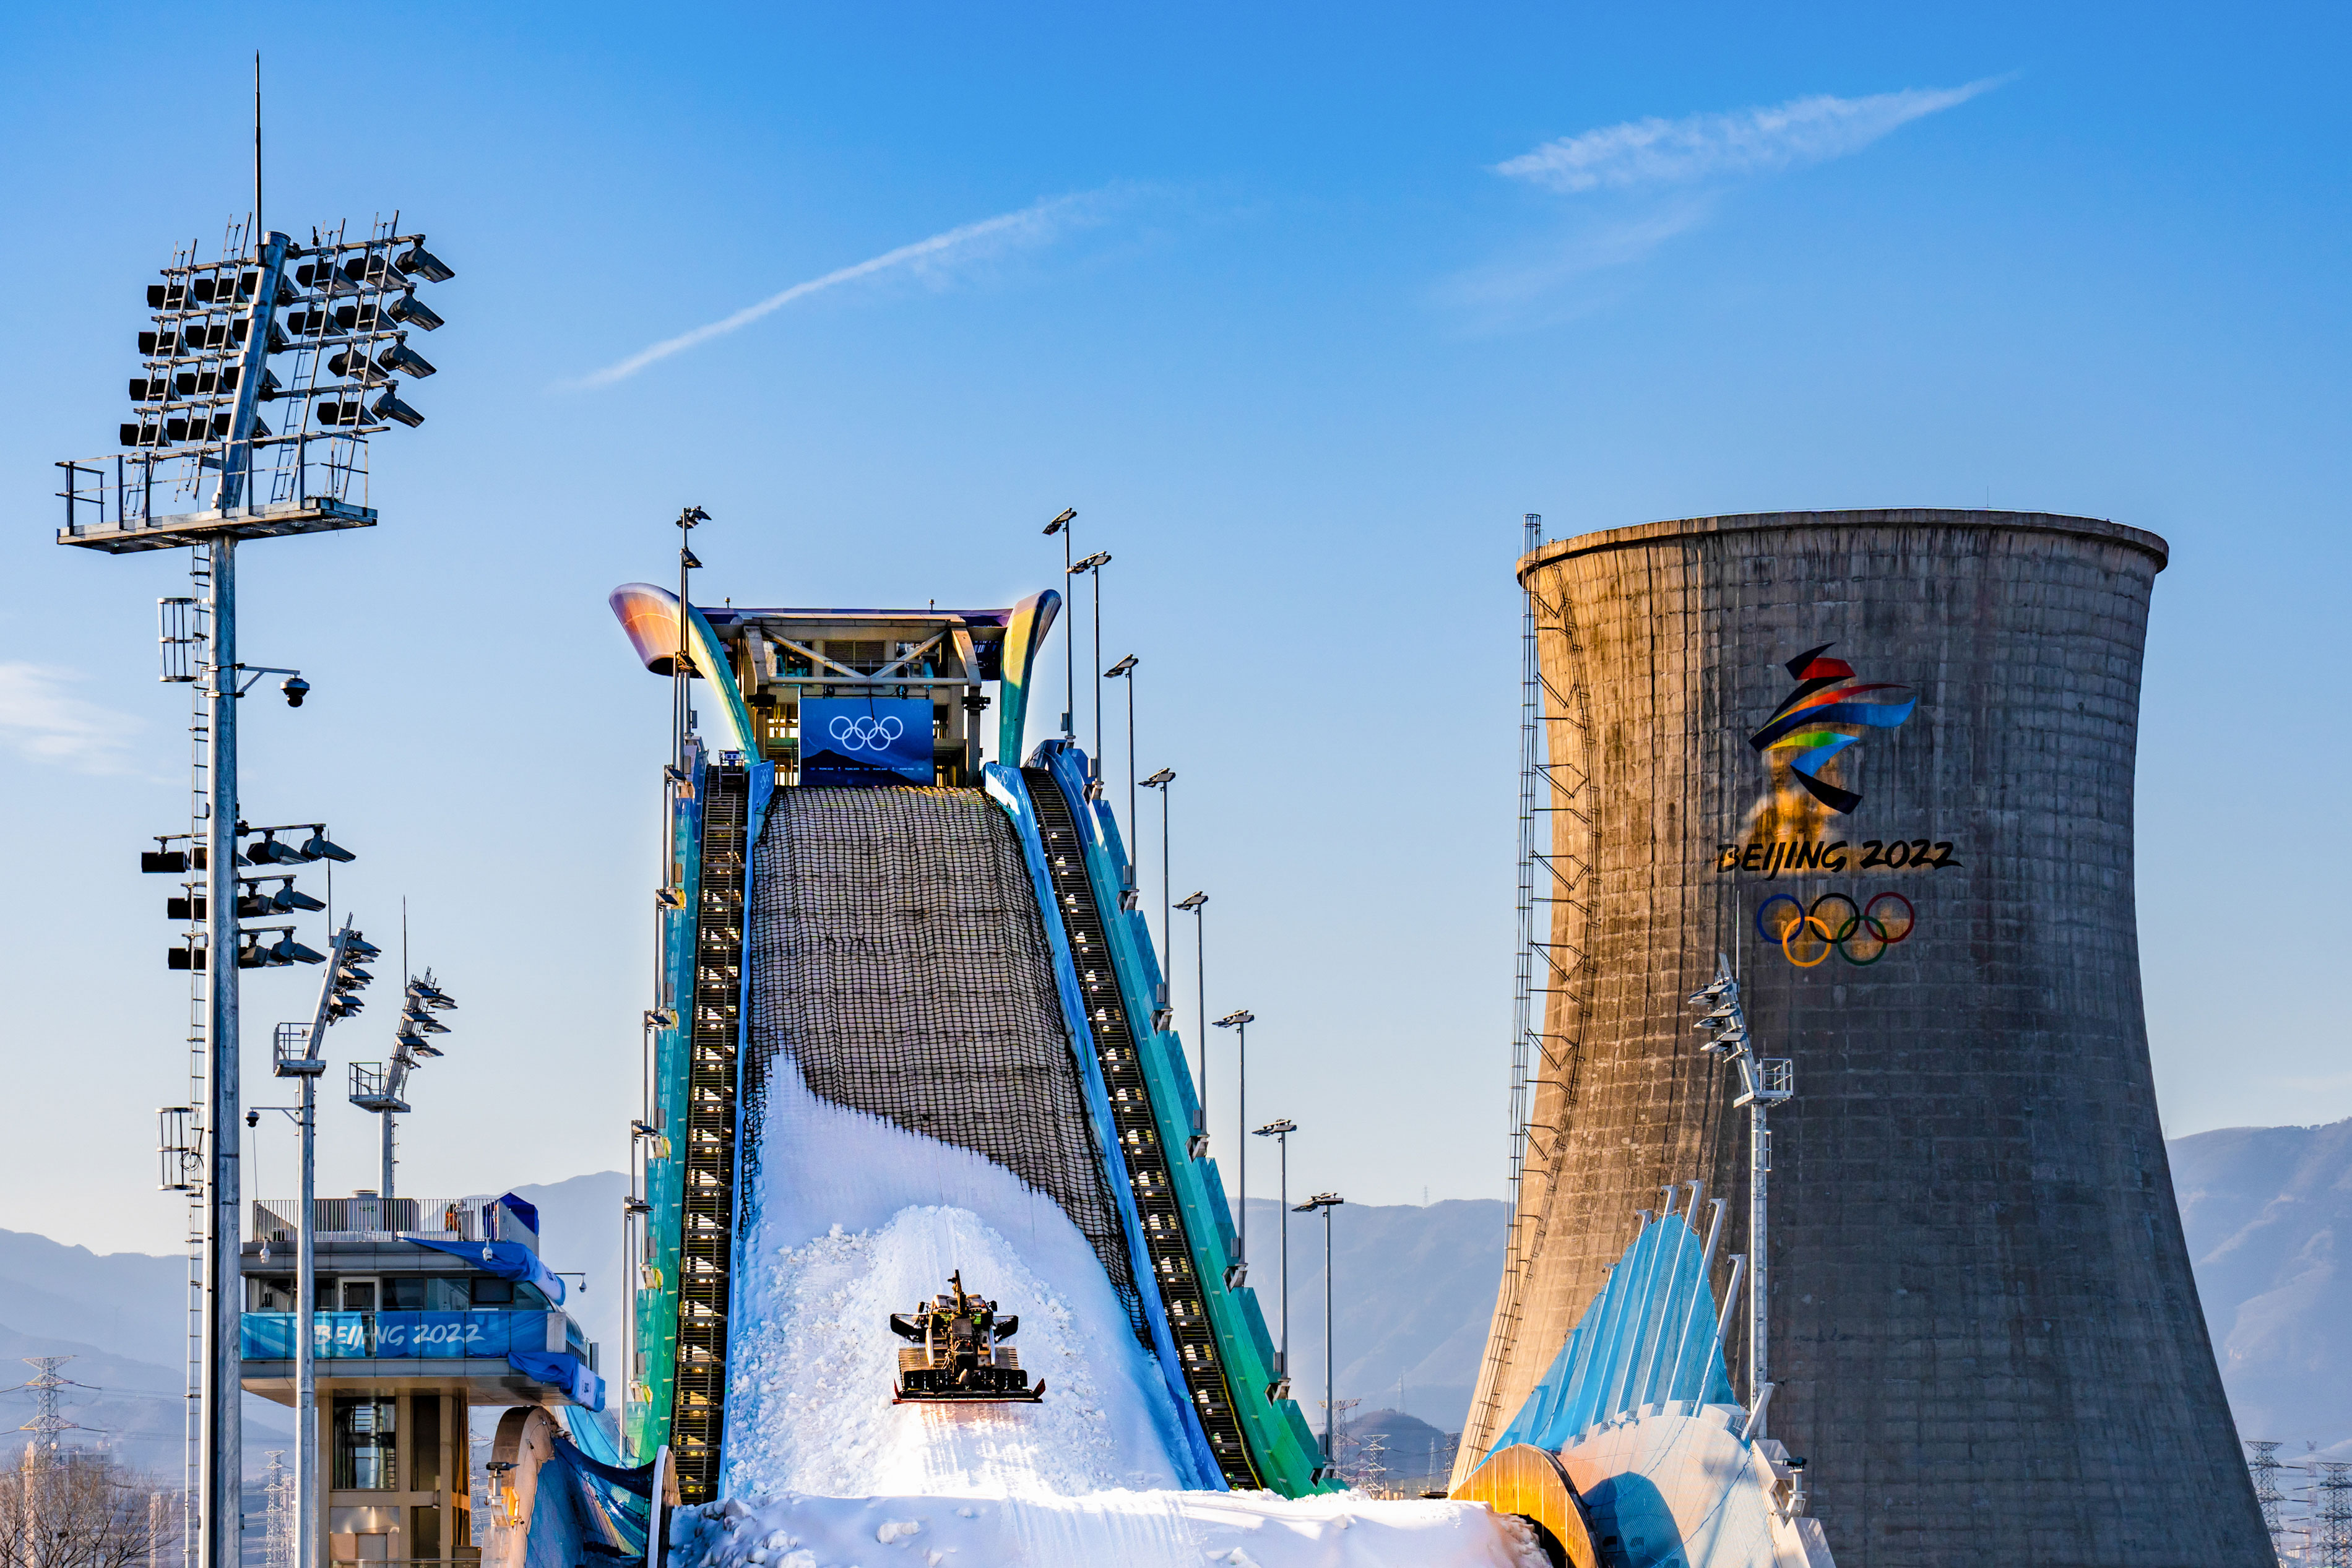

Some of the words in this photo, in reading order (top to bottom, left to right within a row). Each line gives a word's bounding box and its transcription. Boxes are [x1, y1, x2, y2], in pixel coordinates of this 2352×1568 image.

[1716, 840, 1848, 881] BEIJING
[1859, 839, 1965, 871] 2022
[314, 1325, 405, 1351] BEIJNG
[413, 1324, 486, 1344] 2022
